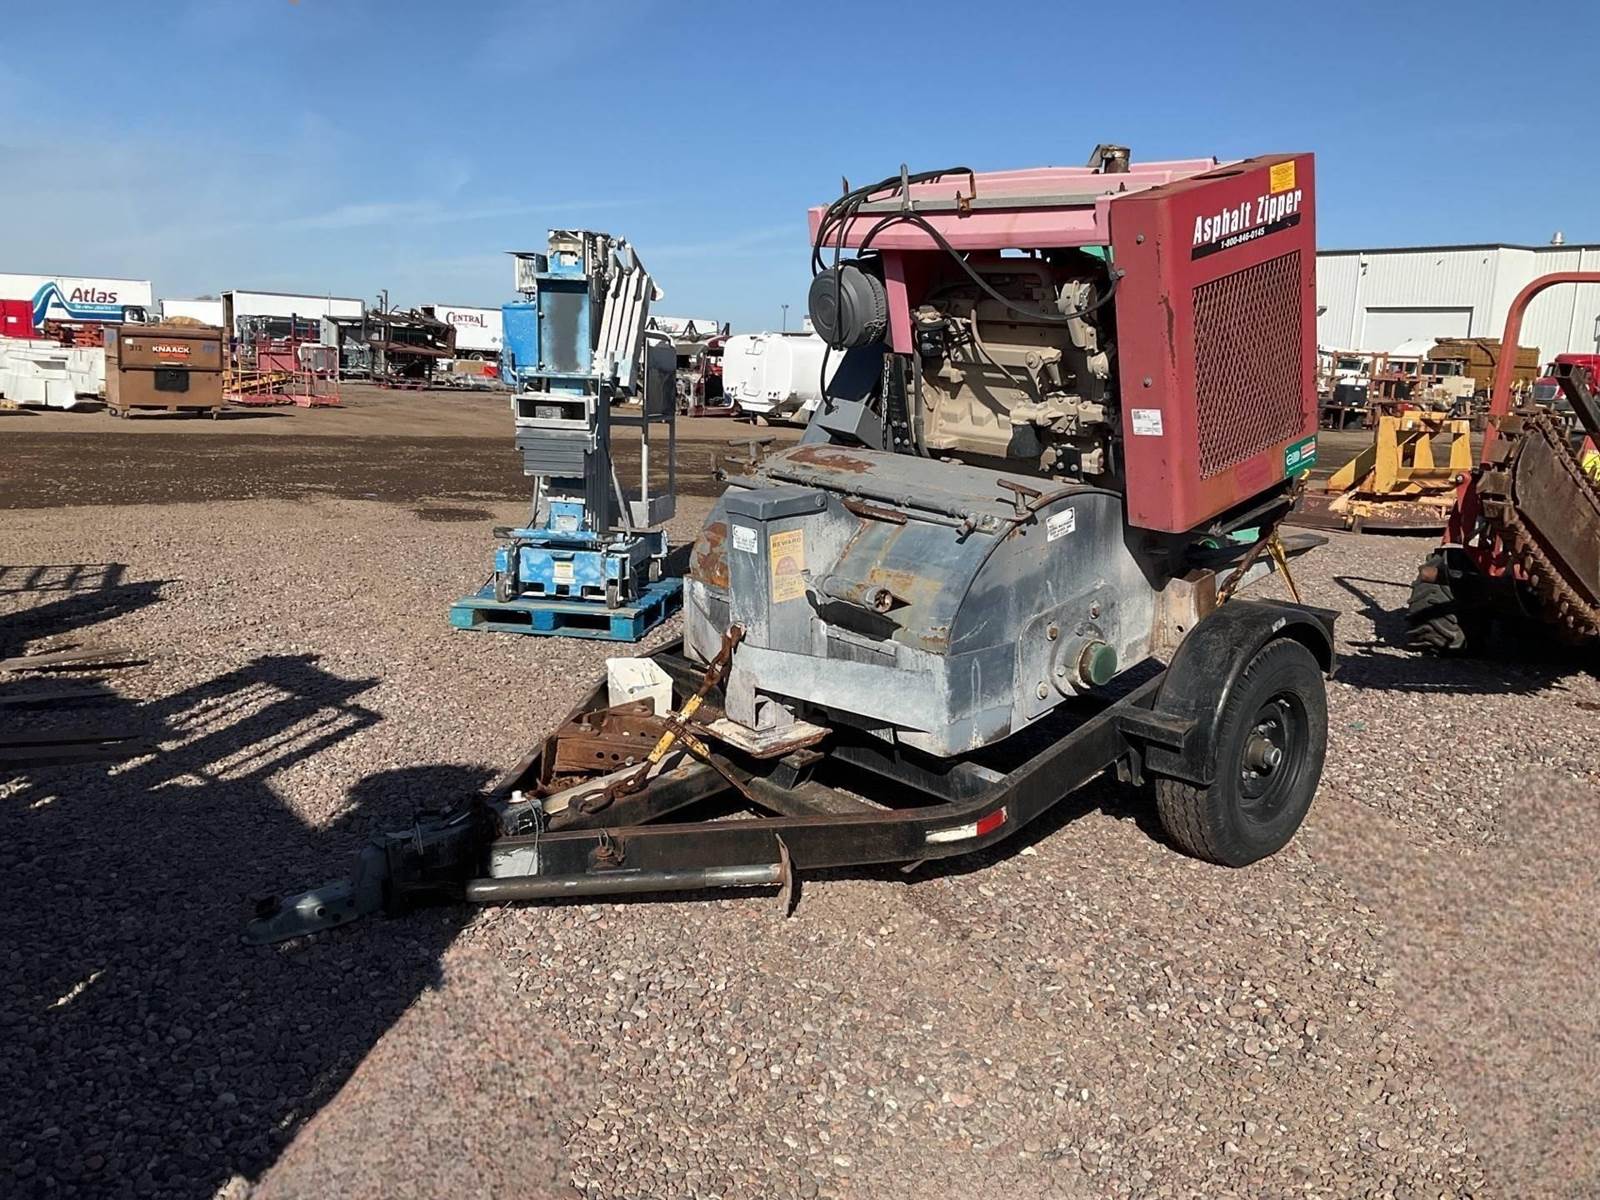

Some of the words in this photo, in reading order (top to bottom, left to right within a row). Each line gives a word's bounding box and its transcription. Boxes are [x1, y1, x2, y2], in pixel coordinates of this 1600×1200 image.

[1192, 202, 1252, 245] Asphalt
[1256, 189, 1302, 225] Zipper
[70, 288, 118, 304] Atlas
[446, 311, 488, 328] CENTRAL
[151, 345, 191, 354] KNAACK
